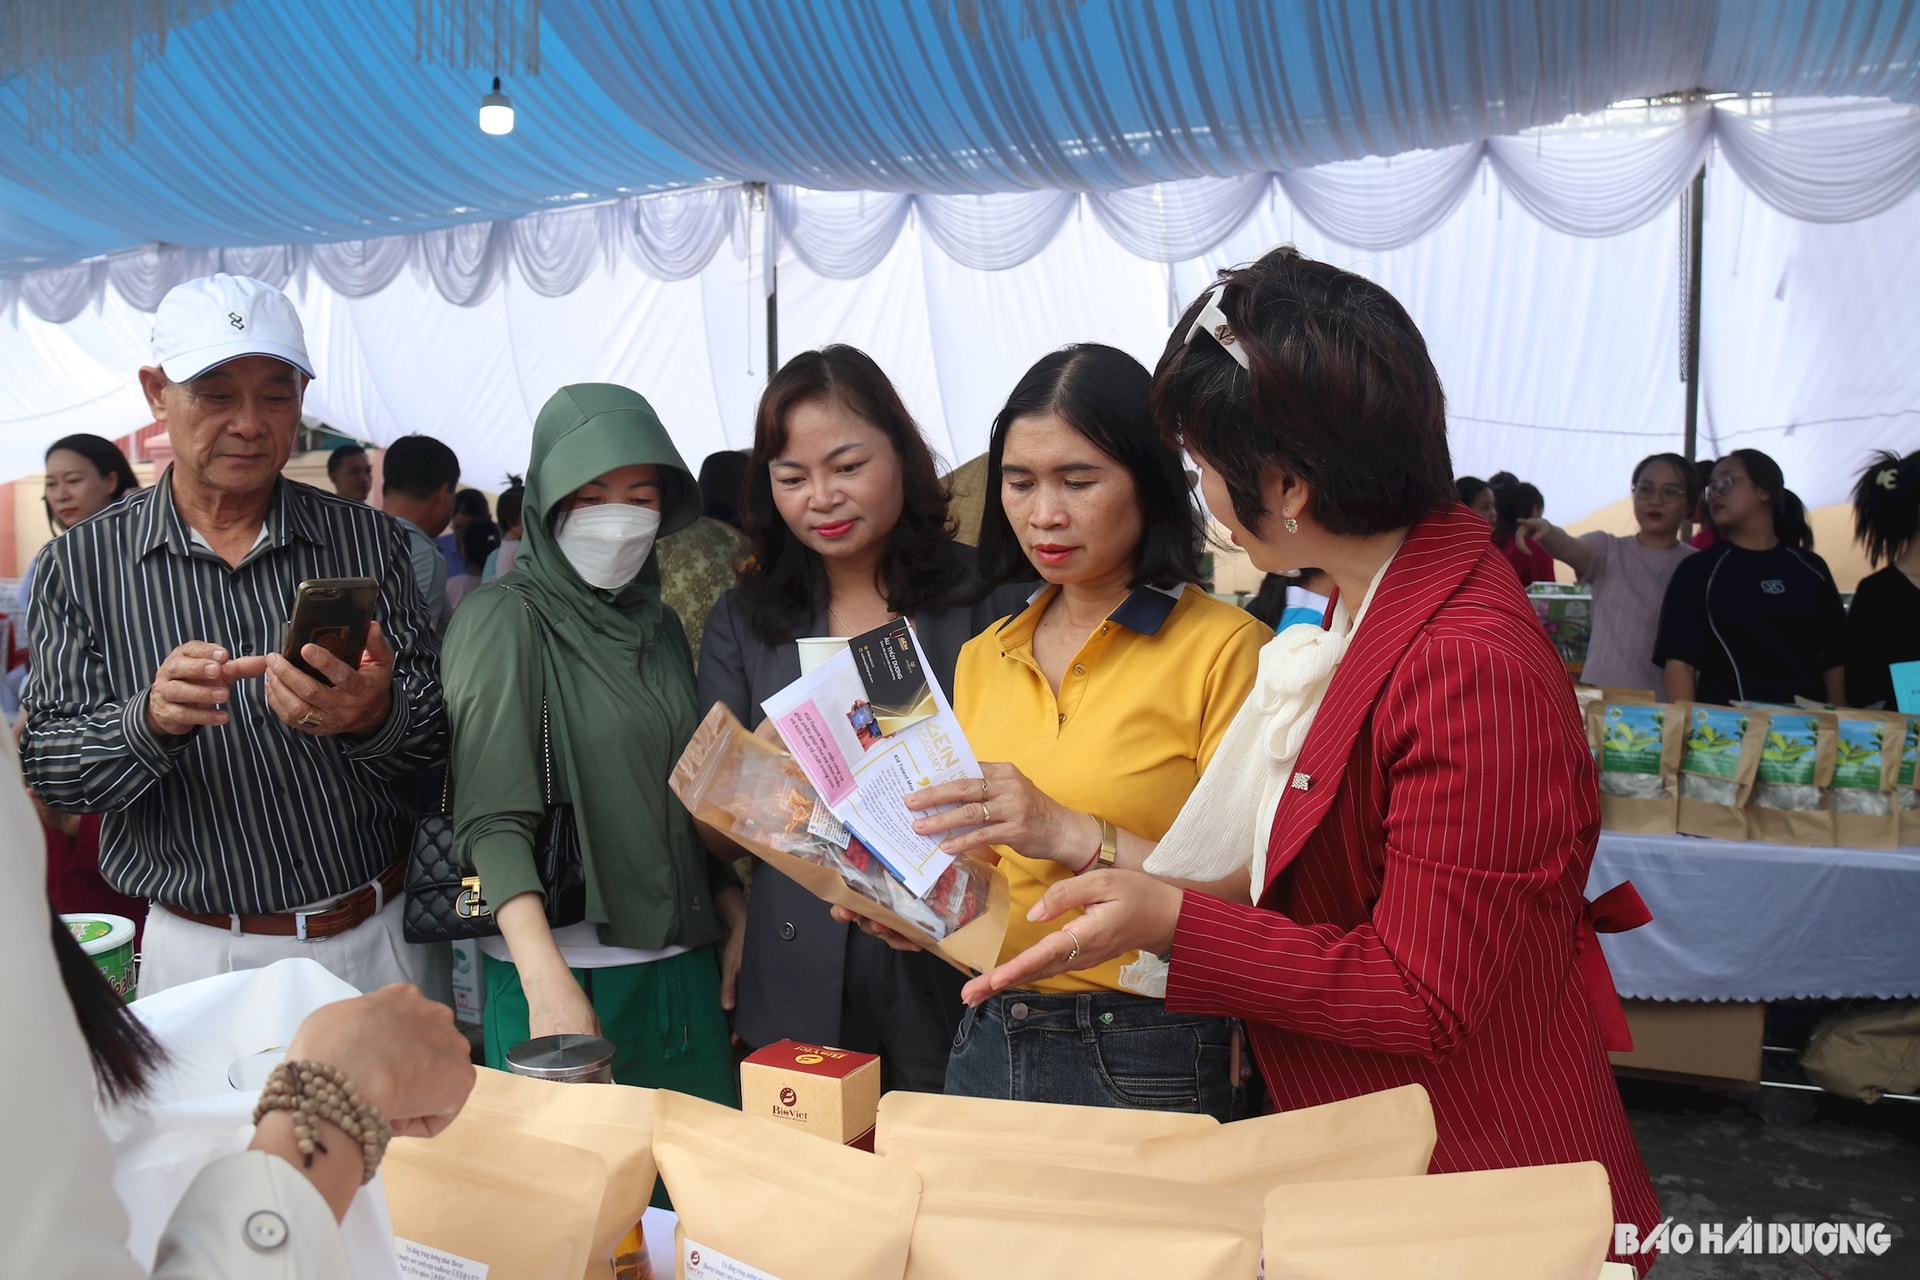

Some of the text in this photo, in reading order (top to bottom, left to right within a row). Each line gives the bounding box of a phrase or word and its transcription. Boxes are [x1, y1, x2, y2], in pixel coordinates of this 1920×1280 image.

[915, 727, 943, 772] ACADEMY
[899, 763, 909, 780] Talent
[907, 780, 915, 792] Map
[794, 1046, 848, 1059] BioViet
[772, 1105, 807, 1120] BioViet
